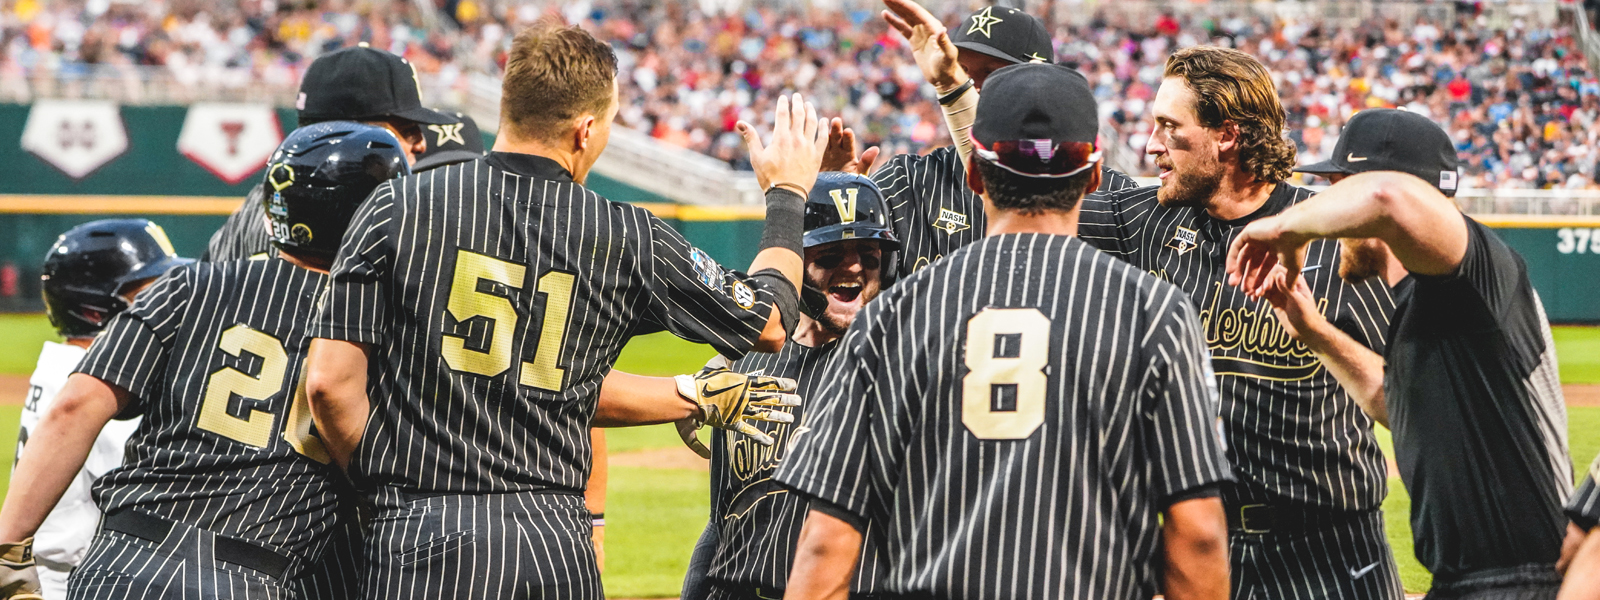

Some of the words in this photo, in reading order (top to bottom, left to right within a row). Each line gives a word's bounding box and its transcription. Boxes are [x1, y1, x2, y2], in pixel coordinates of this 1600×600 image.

[829, 188, 858, 225] V
[941, 211, 965, 223] NASH
[273, 221, 290, 240] 20
[1177, 228, 1196, 242] NASH
[441, 250, 575, 392] 51
[961, 308, 1051, 440] 8
